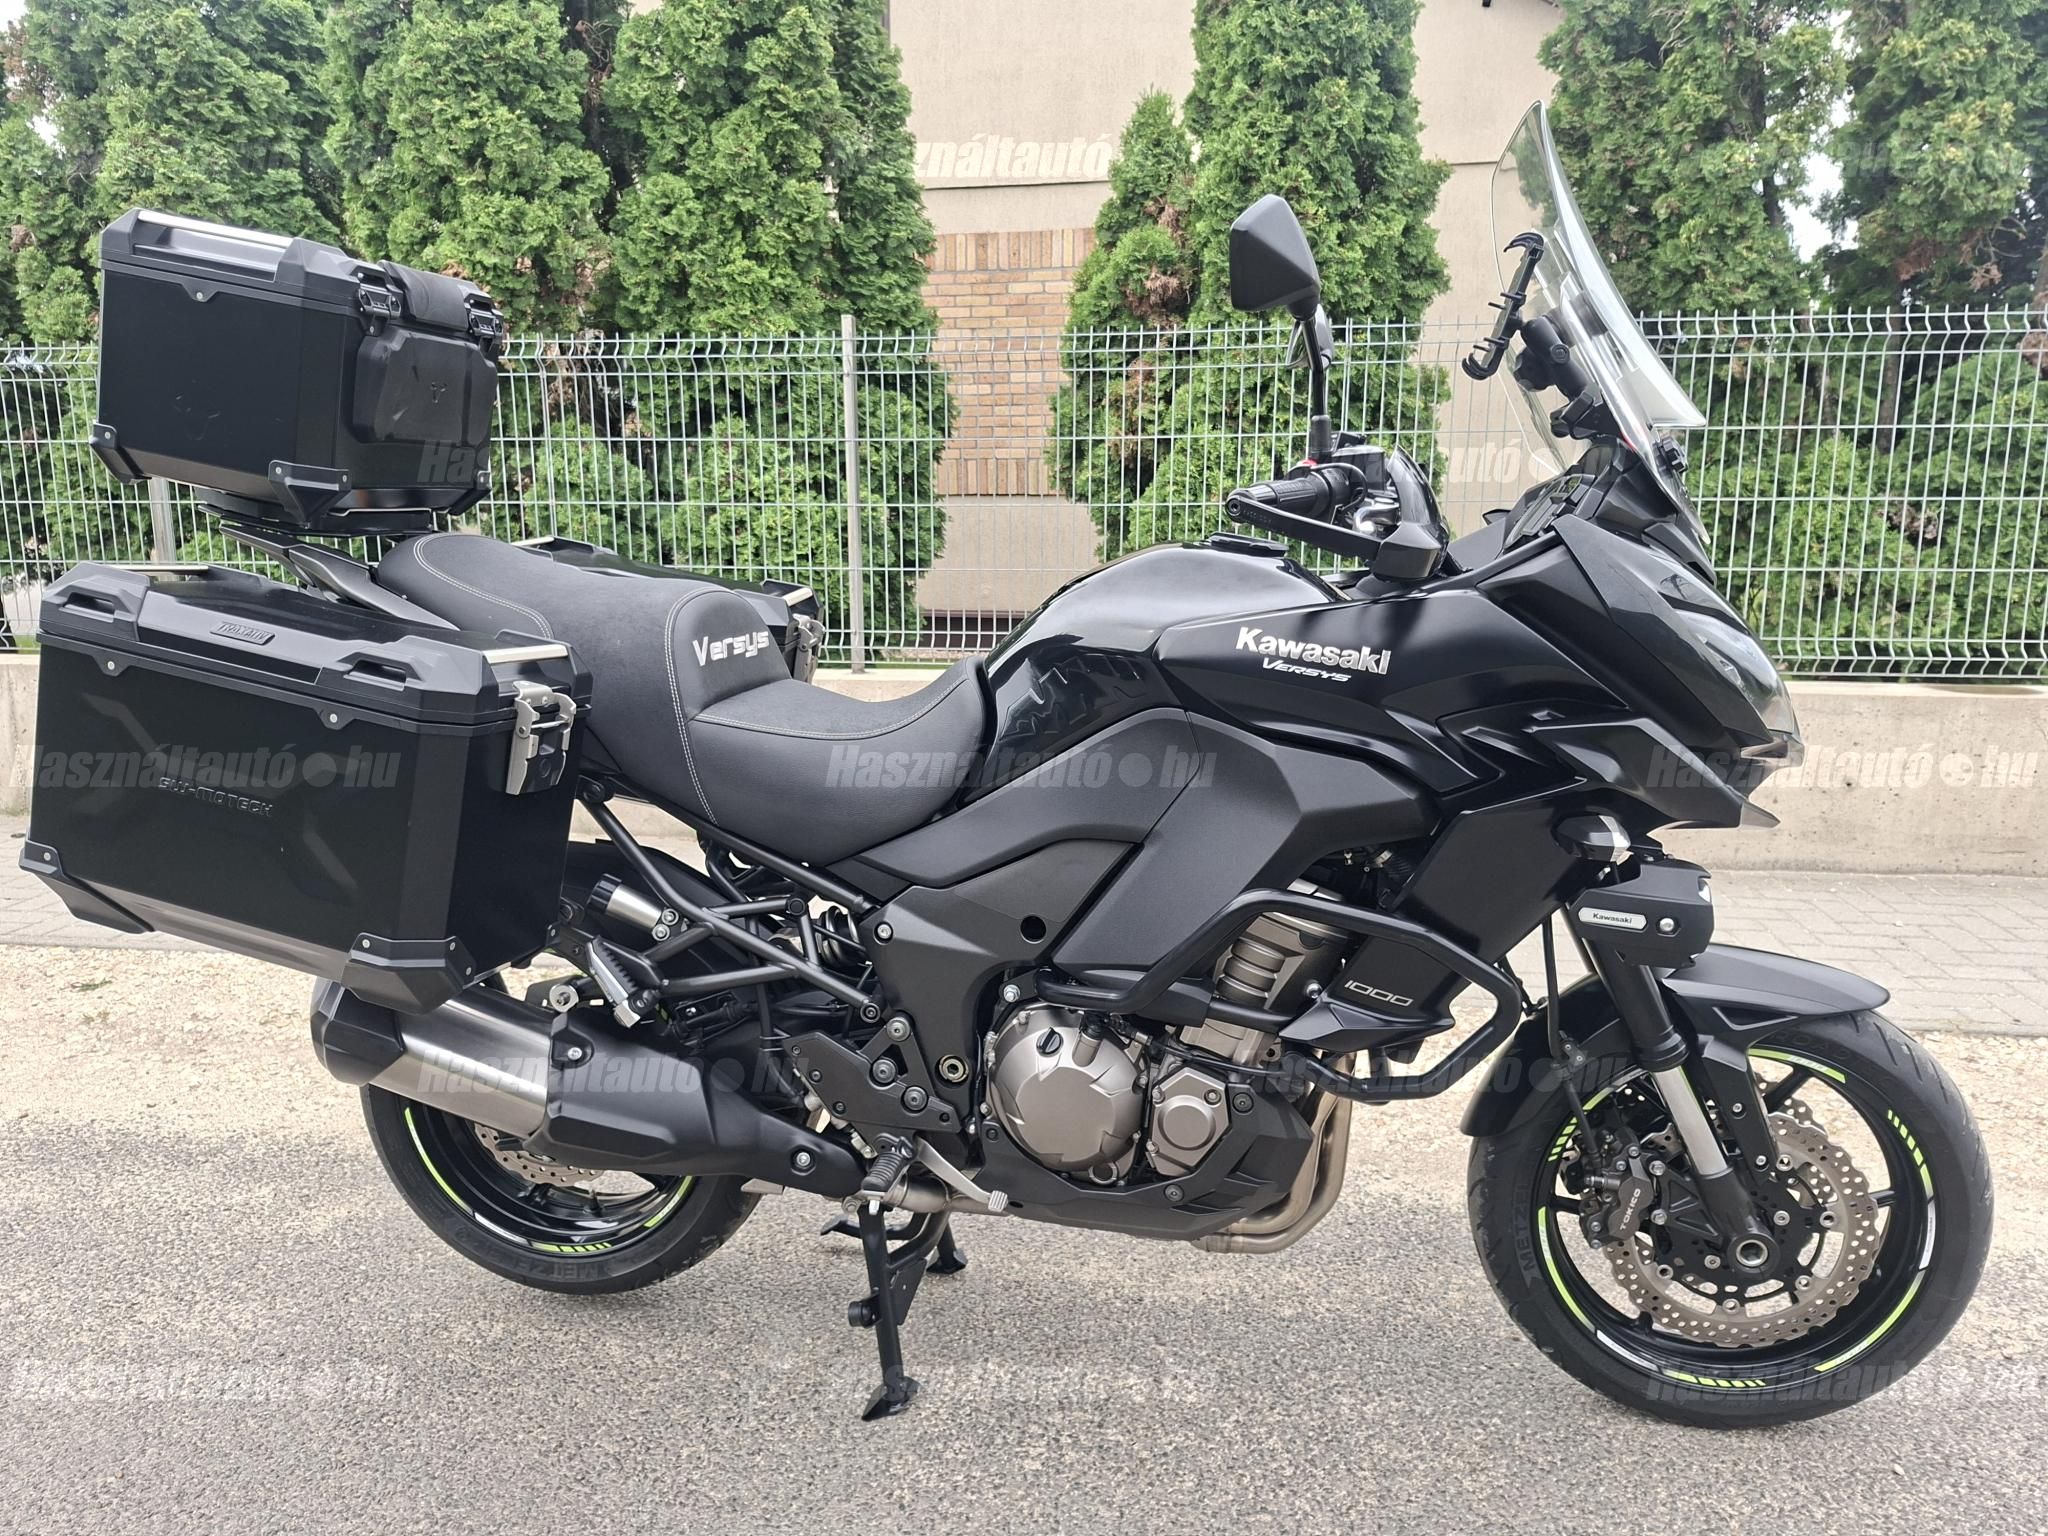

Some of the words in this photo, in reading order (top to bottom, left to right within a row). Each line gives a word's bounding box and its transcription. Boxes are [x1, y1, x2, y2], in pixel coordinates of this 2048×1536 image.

[692, 631, 770, 667] Versys
[1236, 626, 1392, 675] Kawasaki
[1262, 657, 1352, 682] VERSYS
[1593, 912, 1632, 924] Kawasaki
[1344, 980, 1413, 1007] 1000
[1619, 1187, 1642, 1231] TOKICO
